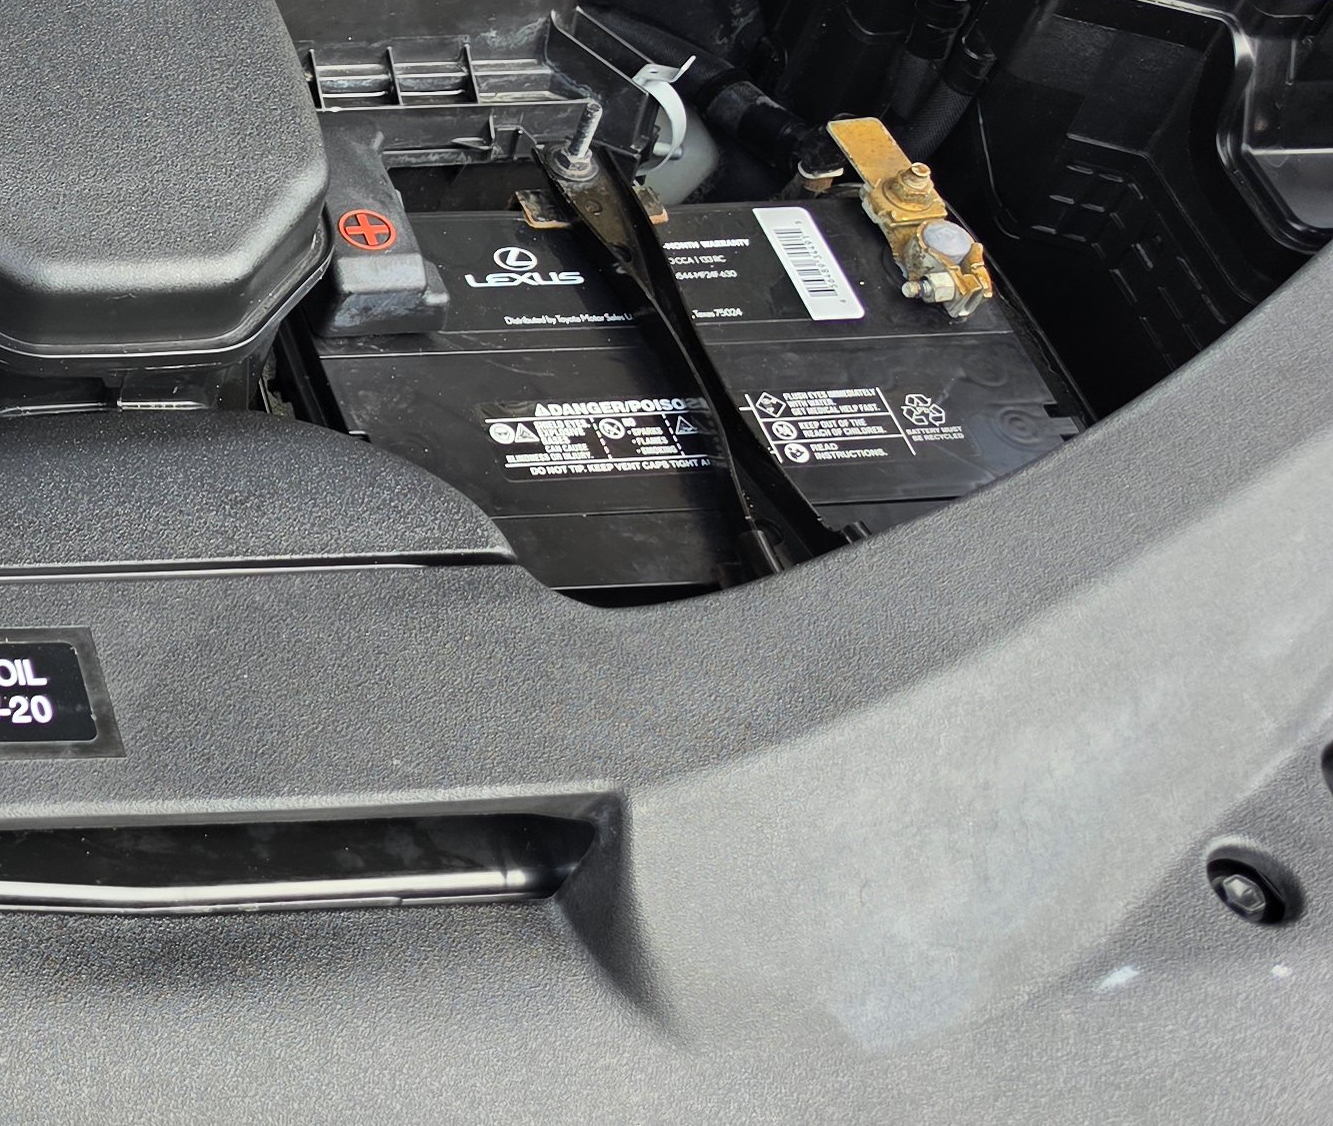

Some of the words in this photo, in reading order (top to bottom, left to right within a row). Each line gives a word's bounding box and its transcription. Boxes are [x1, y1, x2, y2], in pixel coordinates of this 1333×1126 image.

[465, 272, 585, 288] LEXUS
[555, 314, 581, 324] Toyota
[580, 314, 604, 322] Motor
[604, 313, 625, 322] Sales
[807, 391, 827, 399] EYES
[827, 388, 875, 398] IMMEDIATELY
[548, 398, 686, 416] DANGER/POISO
[806, 406, 840, 415] MEDICAL
[839, 404, 859, 413] HELP
[859, 403, 881, 412] FAST.
[798, 421, 819, 430] KEEP
[820, 420, 837, 428] OUT
[838, 419, 849, 427] OF
[849, 418, 867, 426] THE
[802, 429, 832, 438] REACH
[831, 428, 843, 436] OF
[843, 426, 887, 436] CHILDREN.
[923, 433, 965, 441] RECYCLED
[561, 443, 589, 452] CAUSE
[810, 443, 838, 452] READ
[550, 452, 563, 460] OR
[814, 448, 889, 460] INSTRUCTIONS.
[529, 466, 546, 476] DO
[546, 465, 567, 474] NOT
[568, 464, 587, 474] TIP.
[587, 463, 614, 472] KEEP
[614, 462, 641, 471] VENT
[641, 460, 670, 469] CAPS
[669, 459, 699, 468] TIGHT
